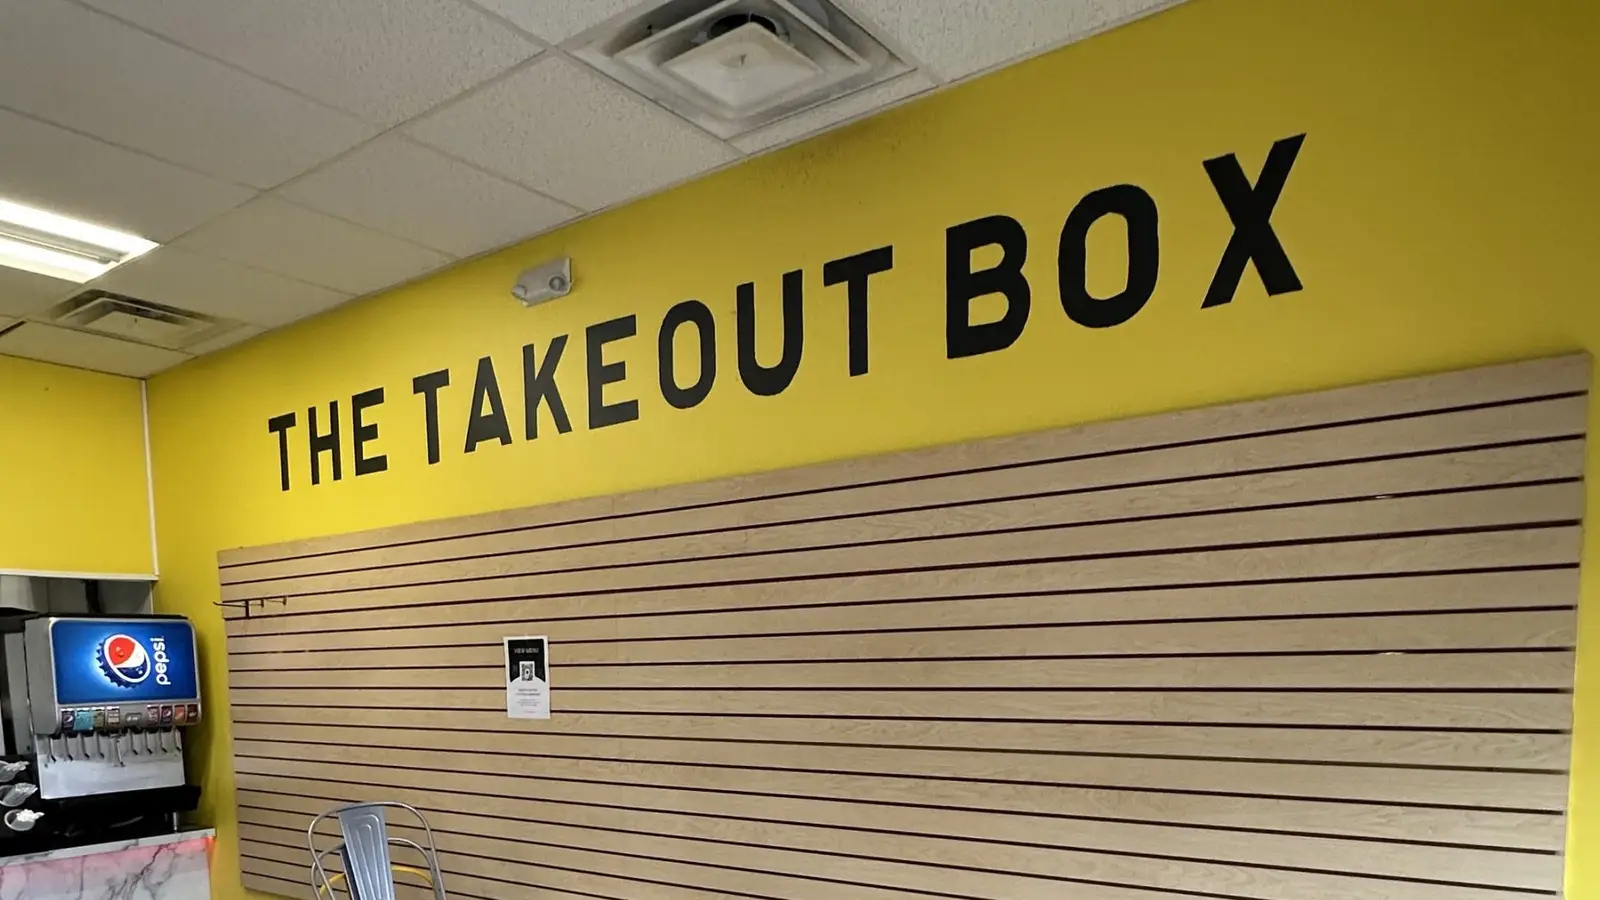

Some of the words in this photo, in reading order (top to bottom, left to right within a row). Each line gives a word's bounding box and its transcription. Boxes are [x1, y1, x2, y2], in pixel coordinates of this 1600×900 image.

[268, 387, 389, 492] THE
[412, 244, 894, 466] TAKEOUT
[945, 132, 1308, 361] BOX
[150, 637, 172, 685] pepsi
